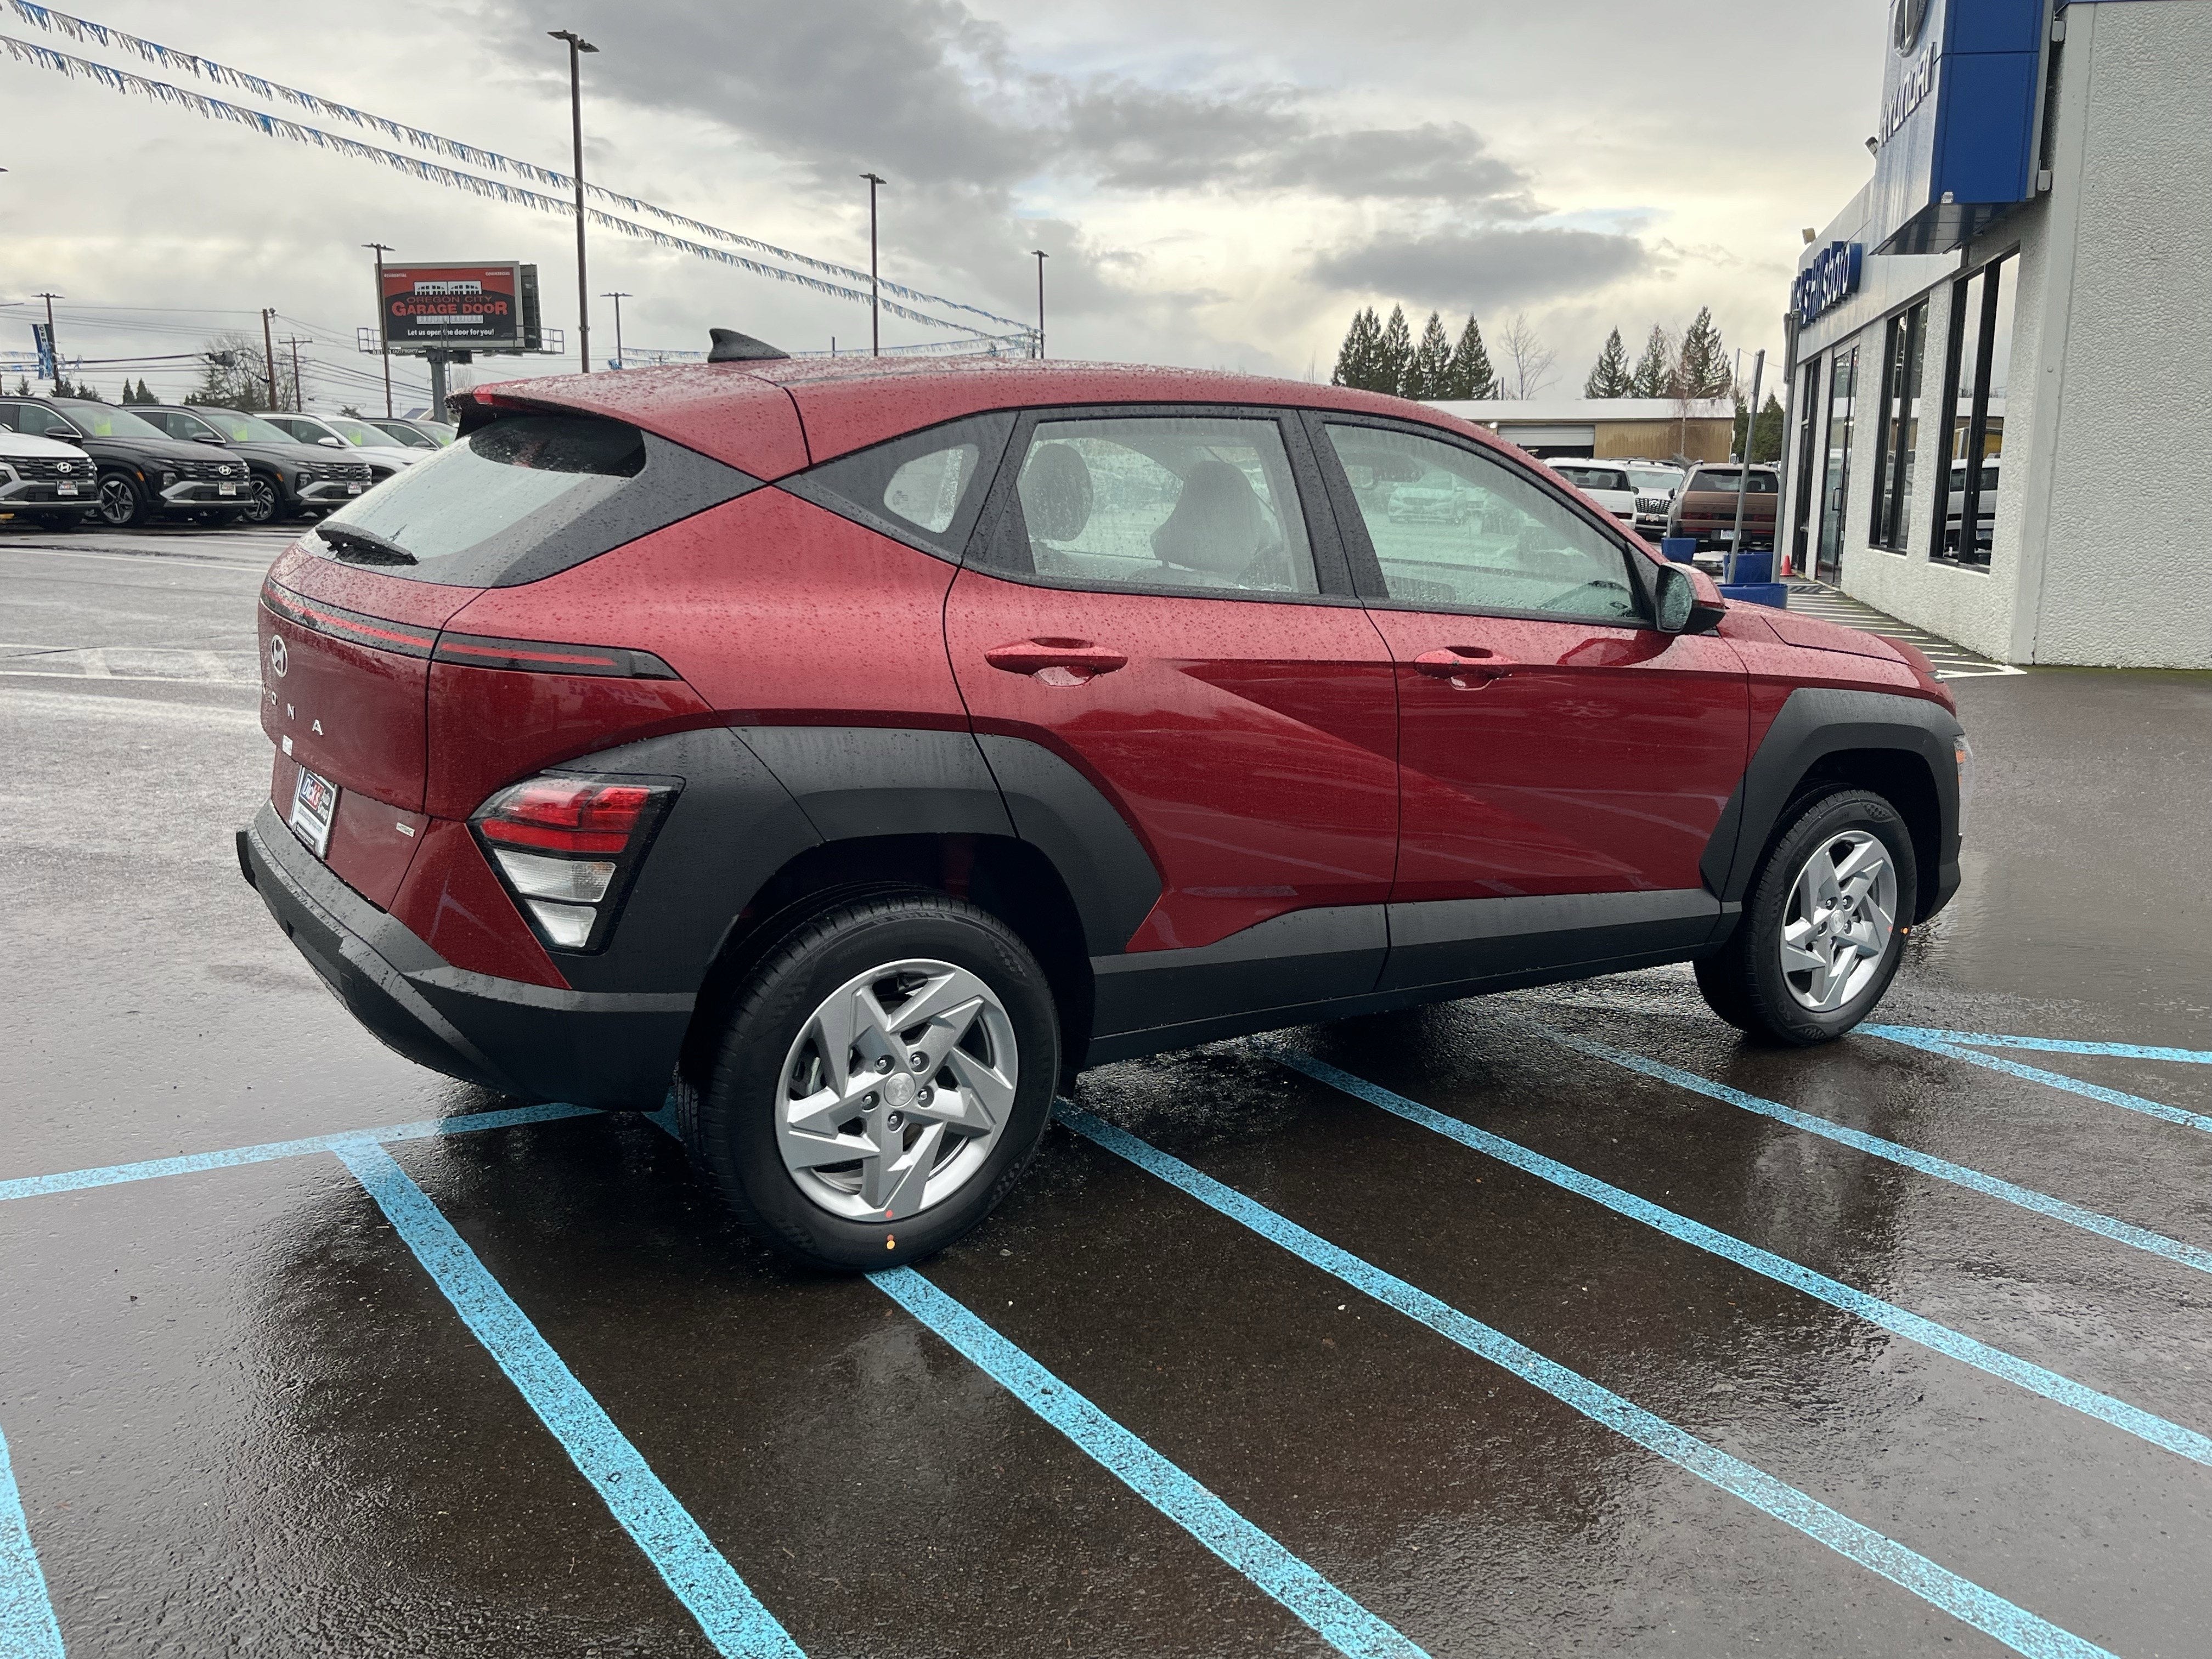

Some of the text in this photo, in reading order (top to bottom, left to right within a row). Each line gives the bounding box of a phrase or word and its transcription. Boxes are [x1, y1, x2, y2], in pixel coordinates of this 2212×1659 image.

[1878, 42, 1937, 147] HYUNDAI
[392, 301, 509, 316] GARAGE DOOR
[480, 329, 494, 337] you!
